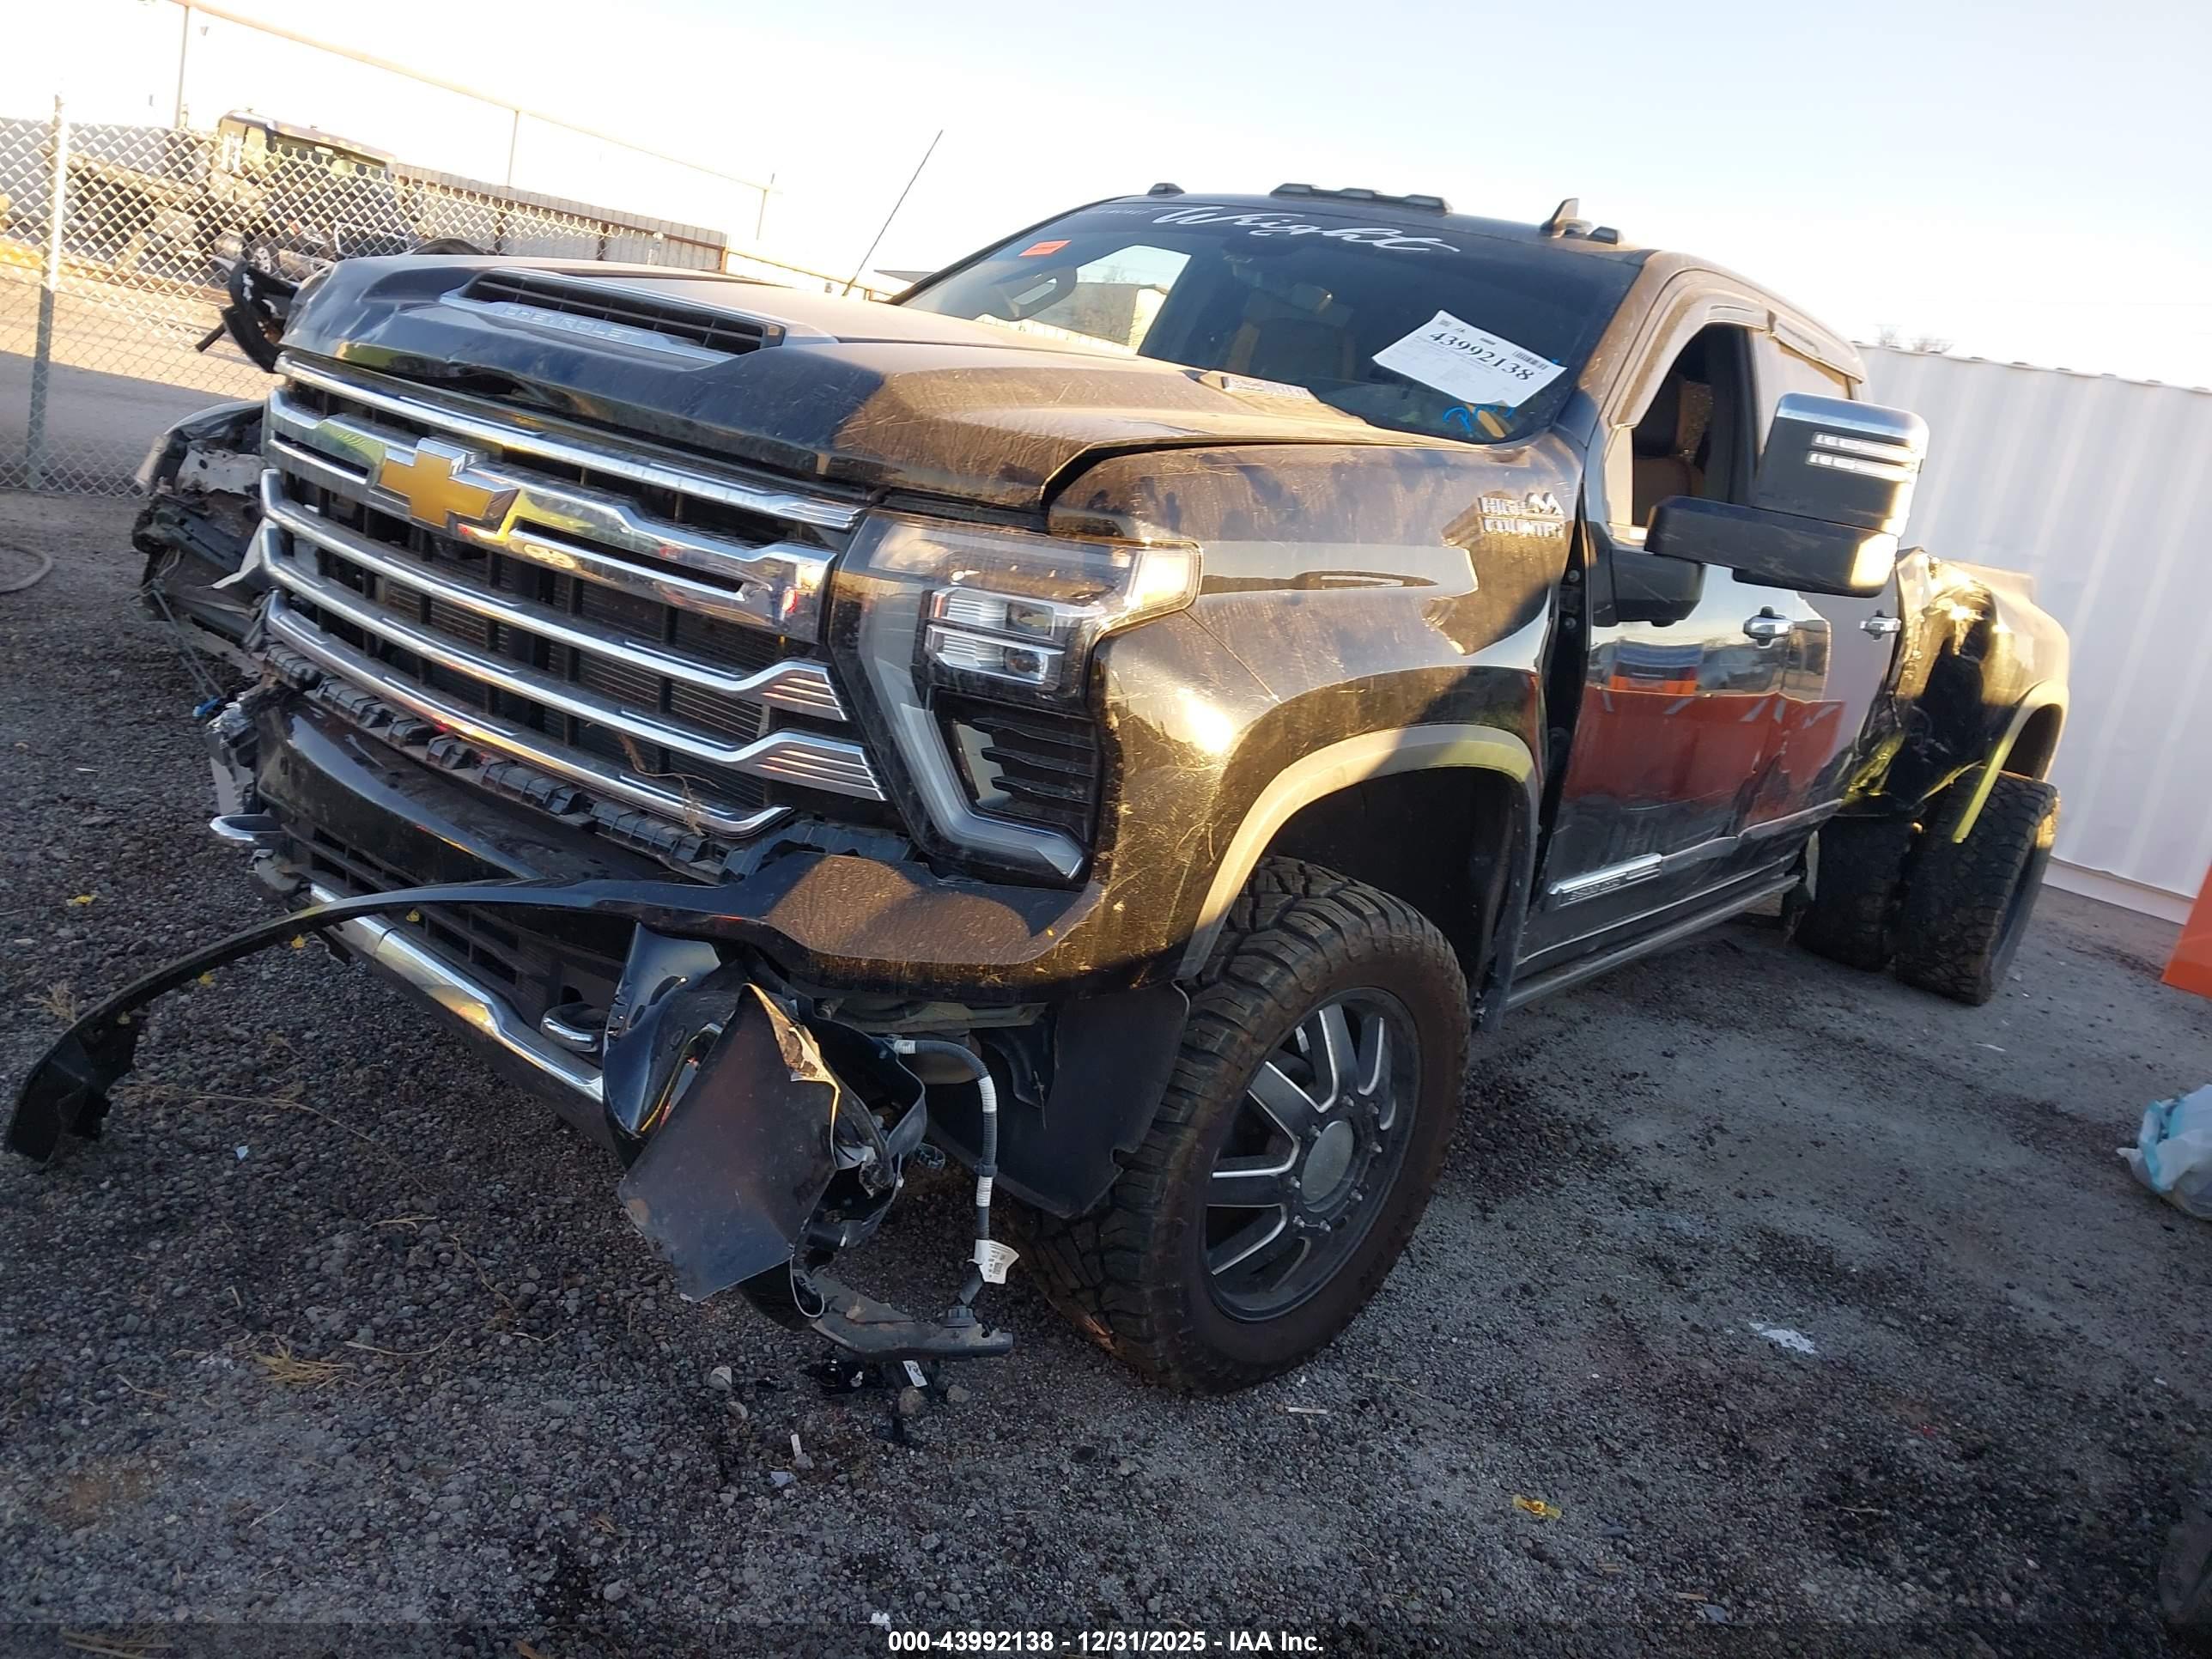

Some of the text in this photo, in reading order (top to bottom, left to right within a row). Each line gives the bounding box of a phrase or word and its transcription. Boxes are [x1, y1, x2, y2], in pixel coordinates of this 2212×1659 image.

[1151, 206, 1461, 252] Wright
[503, 306, 642, 342] CHEVROLET
[1429, 331, 1535, 380] 43992138
[1481, 496, 1528, 515] HIGH
